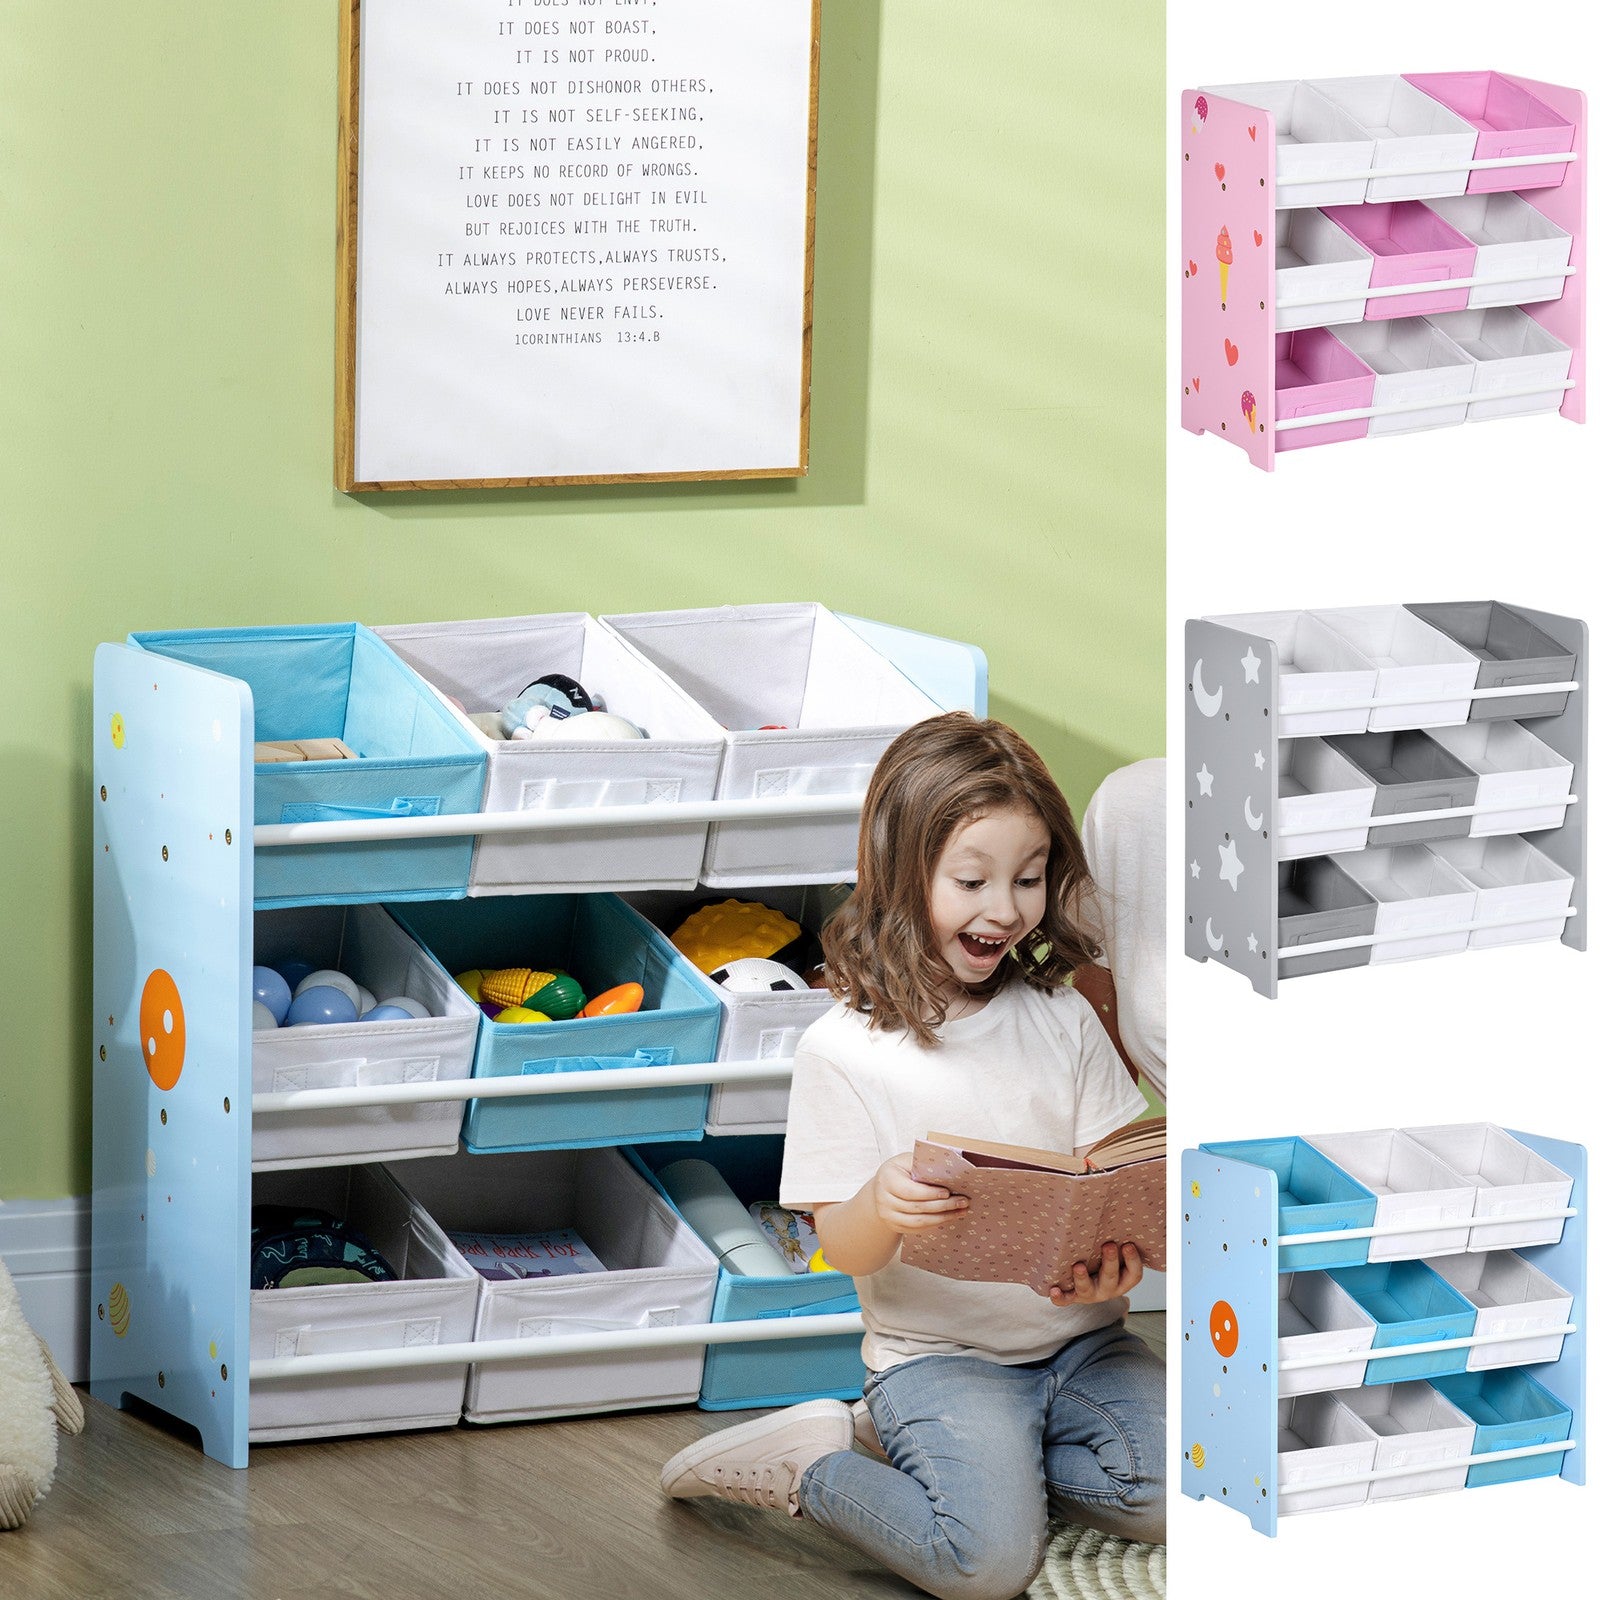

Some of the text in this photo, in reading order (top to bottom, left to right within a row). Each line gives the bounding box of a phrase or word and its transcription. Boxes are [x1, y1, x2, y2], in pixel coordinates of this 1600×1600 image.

[499, 20, 656, 35] IT DOES NOT BOAST,
[517, 49, 655, 63] IT IS NOT PROUD.
[457, 79, 714, 95] IT DOES NOT DISHONOR OTHERS,
[494, 107, 704, 123] IT IS NOT SELF-SEEKING,
[475, 136, 703, 152] IT IS NOT EASILY ANGERED,
[459, 163, 698, 180] IT KEEPS NO RECORD OF WRONGS.
[467, 191, 707, 208] LOVE DOES NOT DELIGHT IN EVIL
[466, 219, 697, 236] BUT REJOICES WITH THE TRUTH.
[438, 254, 453, 267] IT
[463, 252, 516, 266] ALWAYS
[668, 248, 727, 262] TRUSTS,
[445, 281, 498, 295] ALWAYS
[624, 276, 717, 291] PERSEVERSE.
[517, 305, 663, 321] LOVE NEVER FAILS.
[515, 331, 660, 345] 1CORINTHIANS 13:4.B
[490, 1240, 540, 1258] Jack
[540, 1240, 580, 1258] Fox
